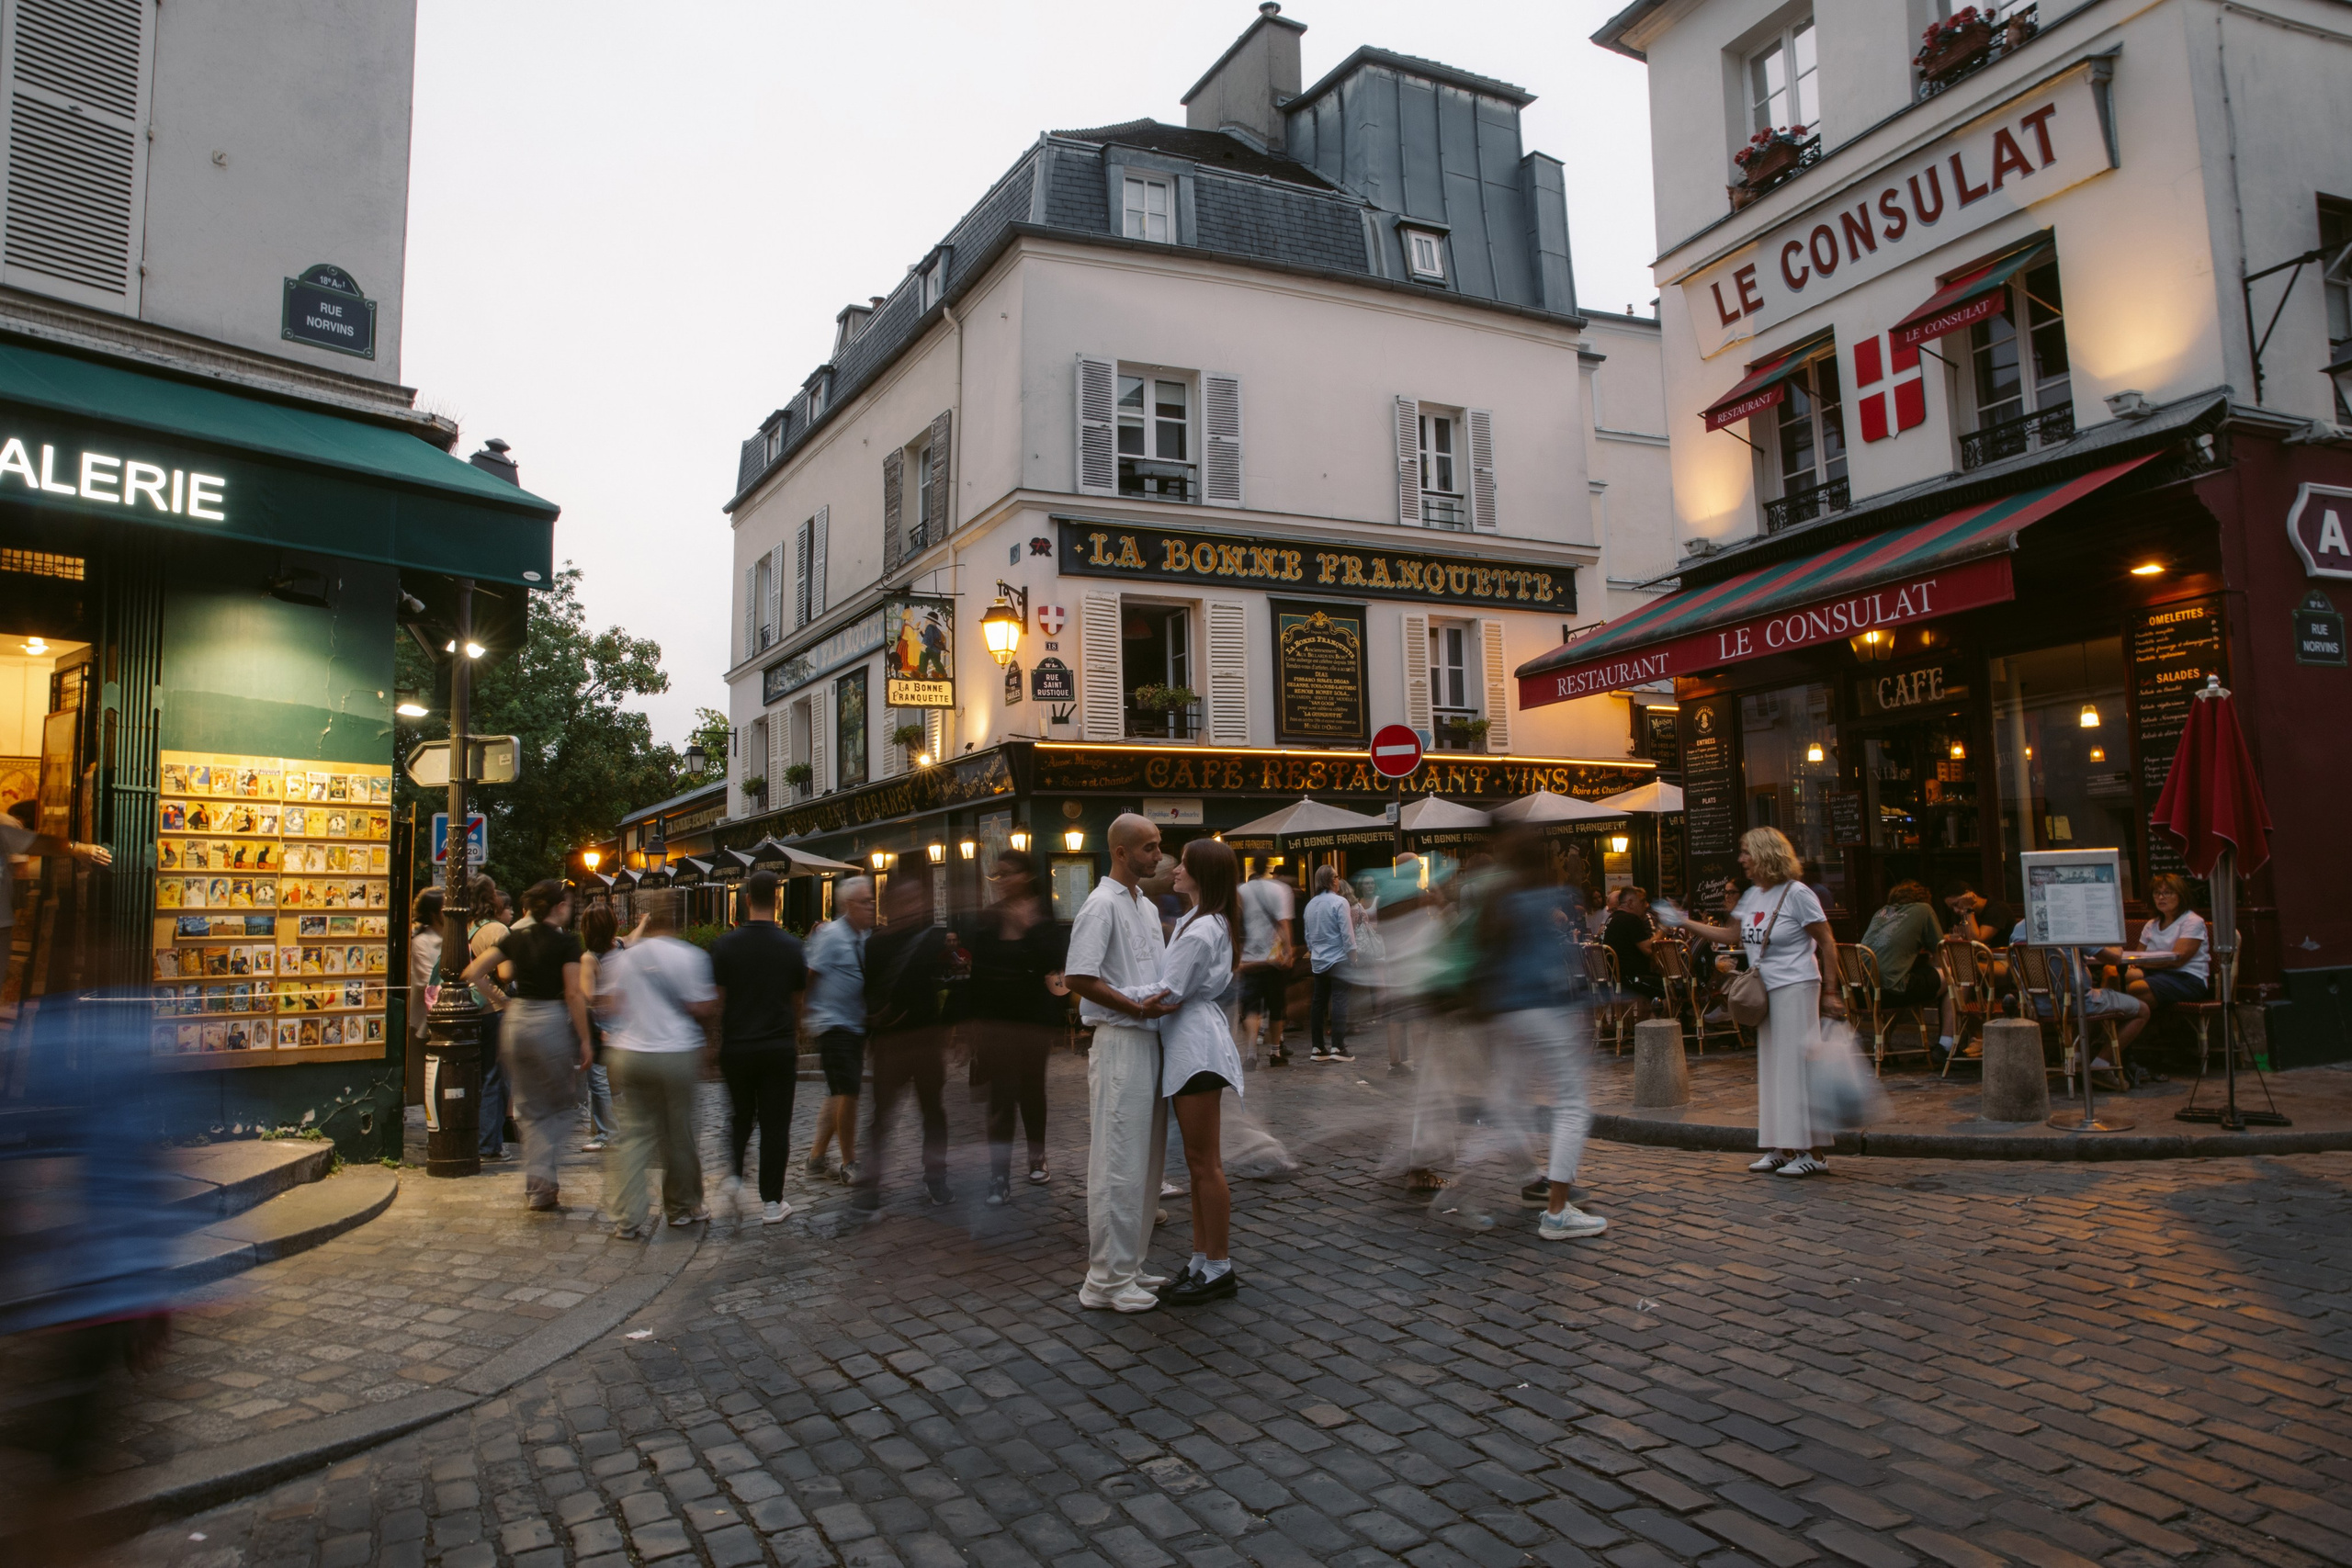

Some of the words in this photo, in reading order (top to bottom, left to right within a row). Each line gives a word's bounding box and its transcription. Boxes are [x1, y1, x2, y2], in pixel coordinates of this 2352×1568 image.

[1710, 263, 1764, 328] LE
[1780, 102, 2056, 291] CONSULAT
[320, 302, 343, 317] RUE
[306, 315, 355, 336] NORVINS
[1905, 328, 1921, 343] LE
[1924, 299, 1989, 334] CONSULAT
[1716, 391, 1772, 423] RESTAURANT
[0, 438, 226, 521] ALERIE
[1088, 532, 1147, 570] LA
[1160, 538, 1304, 582] BONNE
[1315, 551, 1555, 603] FRANQUETTE
[1718, 626, 1754, 660] LE
[1764, 579, 1939, 649] CONSULAT
[2148, 607, 2205, 626] OMELETTES
[2311, 623, 2329, 637] RUE
[1294, 637, 1317, 649] BONNE
[1317, 636, 1355, 659] FRANQUETTE
[2302, 640, 2340, 654] NORVINS
[1009, 676, 1018, 686] RUE
[1555, 652, 1670, 697] RESTAURANT
[2155, 668, 2201, 684] SALADES
[891, 691, 949, 703] FRANQUETTE
[898, 682, 910, 692] LA
[913, 682, 944, 693] BONNE
[1876, 666, 1945, 710] CAFE
[1061, 775, 1088, 787] Boire
[1088, 777, 1099, 787] et
[1146, 756, 1244, 790] CAFÉ
[1504, 765, 1570, 795] VINS
[1572, 784, 1591, 795] Boire
[1591, 786, 1600, 795] et
[854, 784, 914, 822] CABARET
[1702, 796, 1717, 805] PLATS
[1545, 824, 1574, 836] BONNE
[1576, 820, 1627, 833] FRANQUETTE
[1288, 840, 1302, 850] LA
[1303, 836, 1335, 848] BONNE
[1336, 830, 1395, 845] FRANQUETTE
[1421, 834, 1433, 844] LA
[1433, 833, 1463, 844] BONNE
